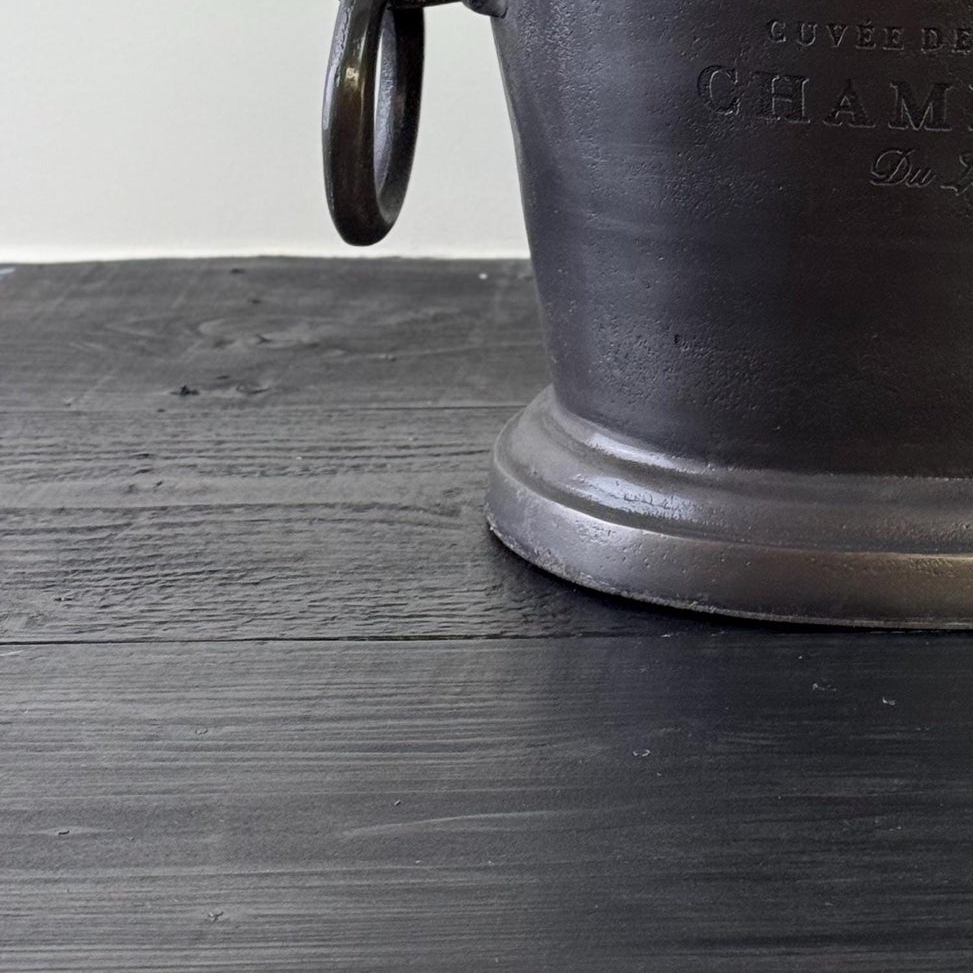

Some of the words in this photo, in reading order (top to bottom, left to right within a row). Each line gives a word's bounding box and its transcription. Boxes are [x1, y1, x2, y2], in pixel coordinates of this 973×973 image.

[769, 19, 905, 50] CUVÉE
[920, 28, 973, 54] DE
[870, 148, 937, 188] Du
